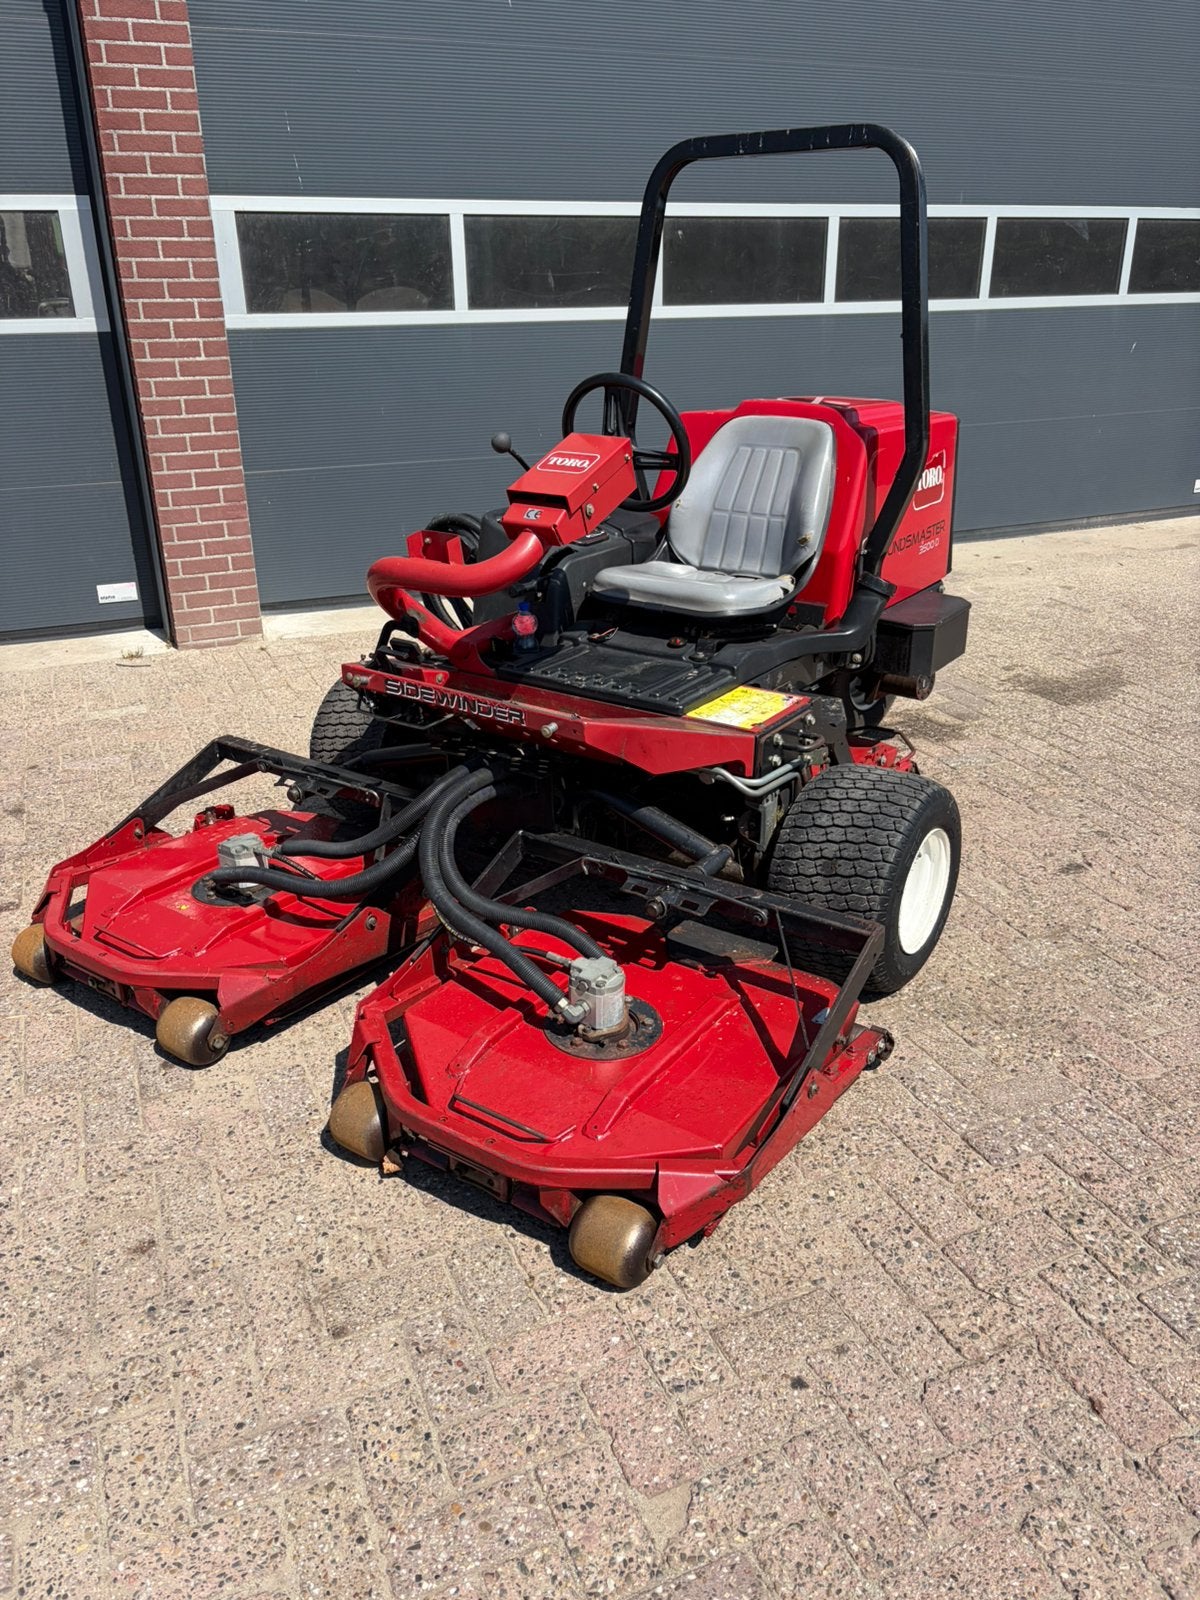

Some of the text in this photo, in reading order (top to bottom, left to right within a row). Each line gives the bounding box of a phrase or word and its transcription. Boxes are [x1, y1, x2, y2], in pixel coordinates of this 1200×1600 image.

[547, 456, 590, 469] TORO
[887, 519, 946, 556] UNDSMASTER
[385, 679, 527, 726] SIDEWINDER
